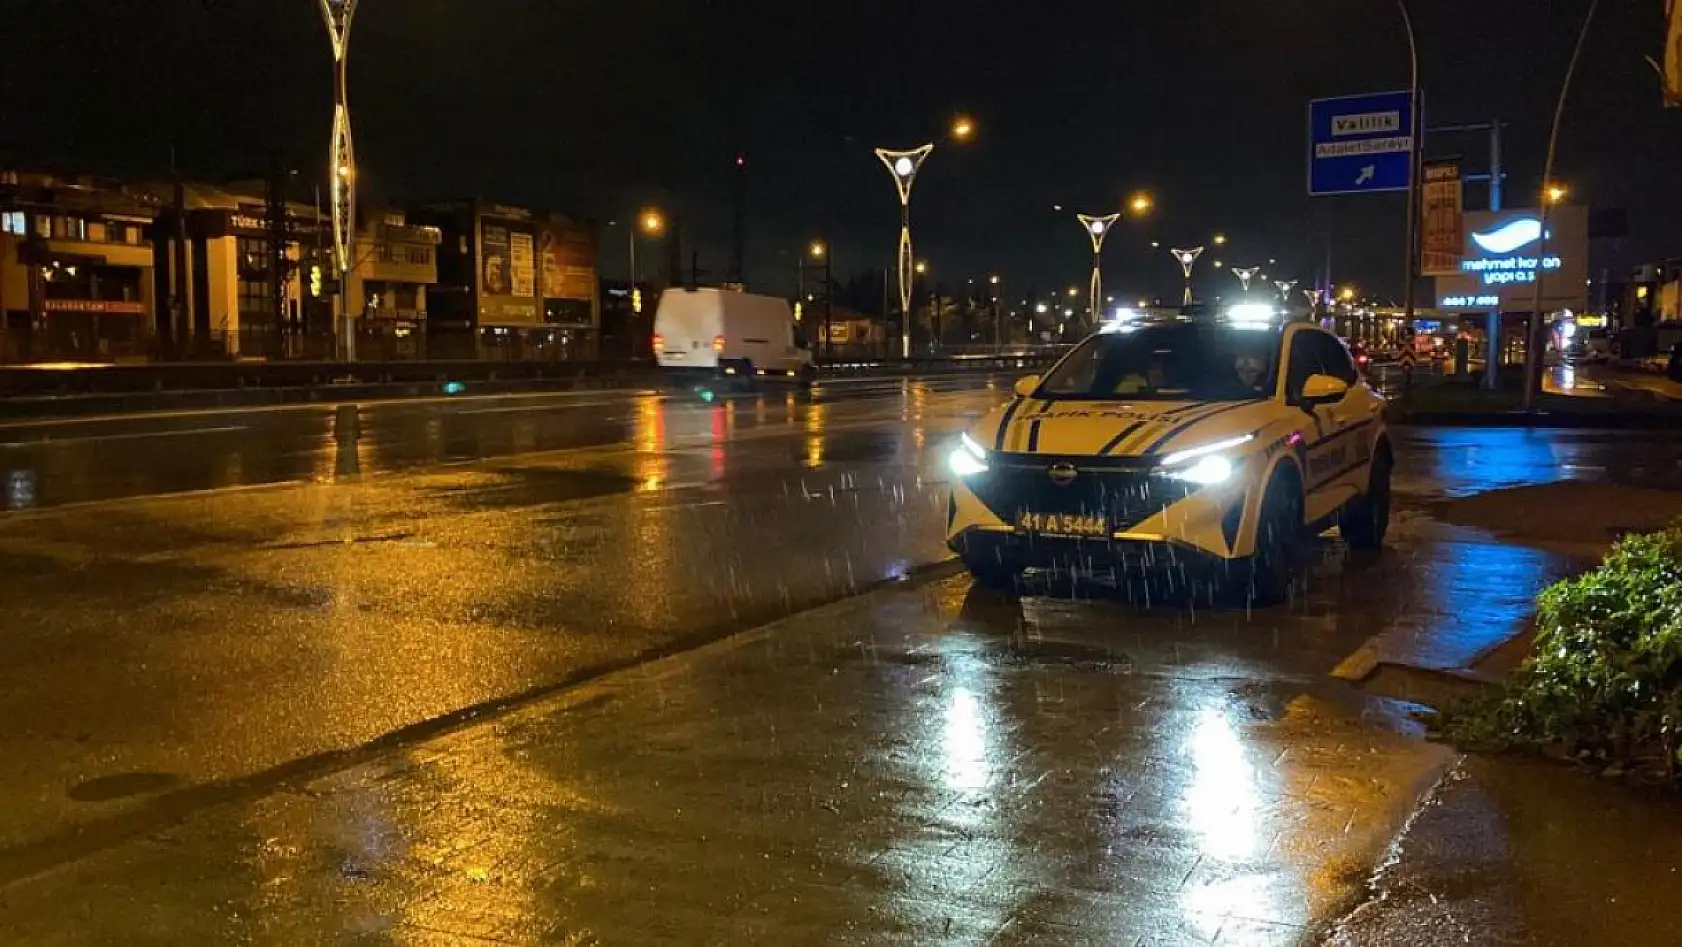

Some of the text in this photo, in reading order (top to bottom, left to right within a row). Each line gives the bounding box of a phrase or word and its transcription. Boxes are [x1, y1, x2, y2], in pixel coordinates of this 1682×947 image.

[1336, 115, 1393, 131] Valilik
[1463, 257, 1516, 270] mehmet
[1021, 511, 1041, 531] 41
[1046, 514, 1059, 532] A
